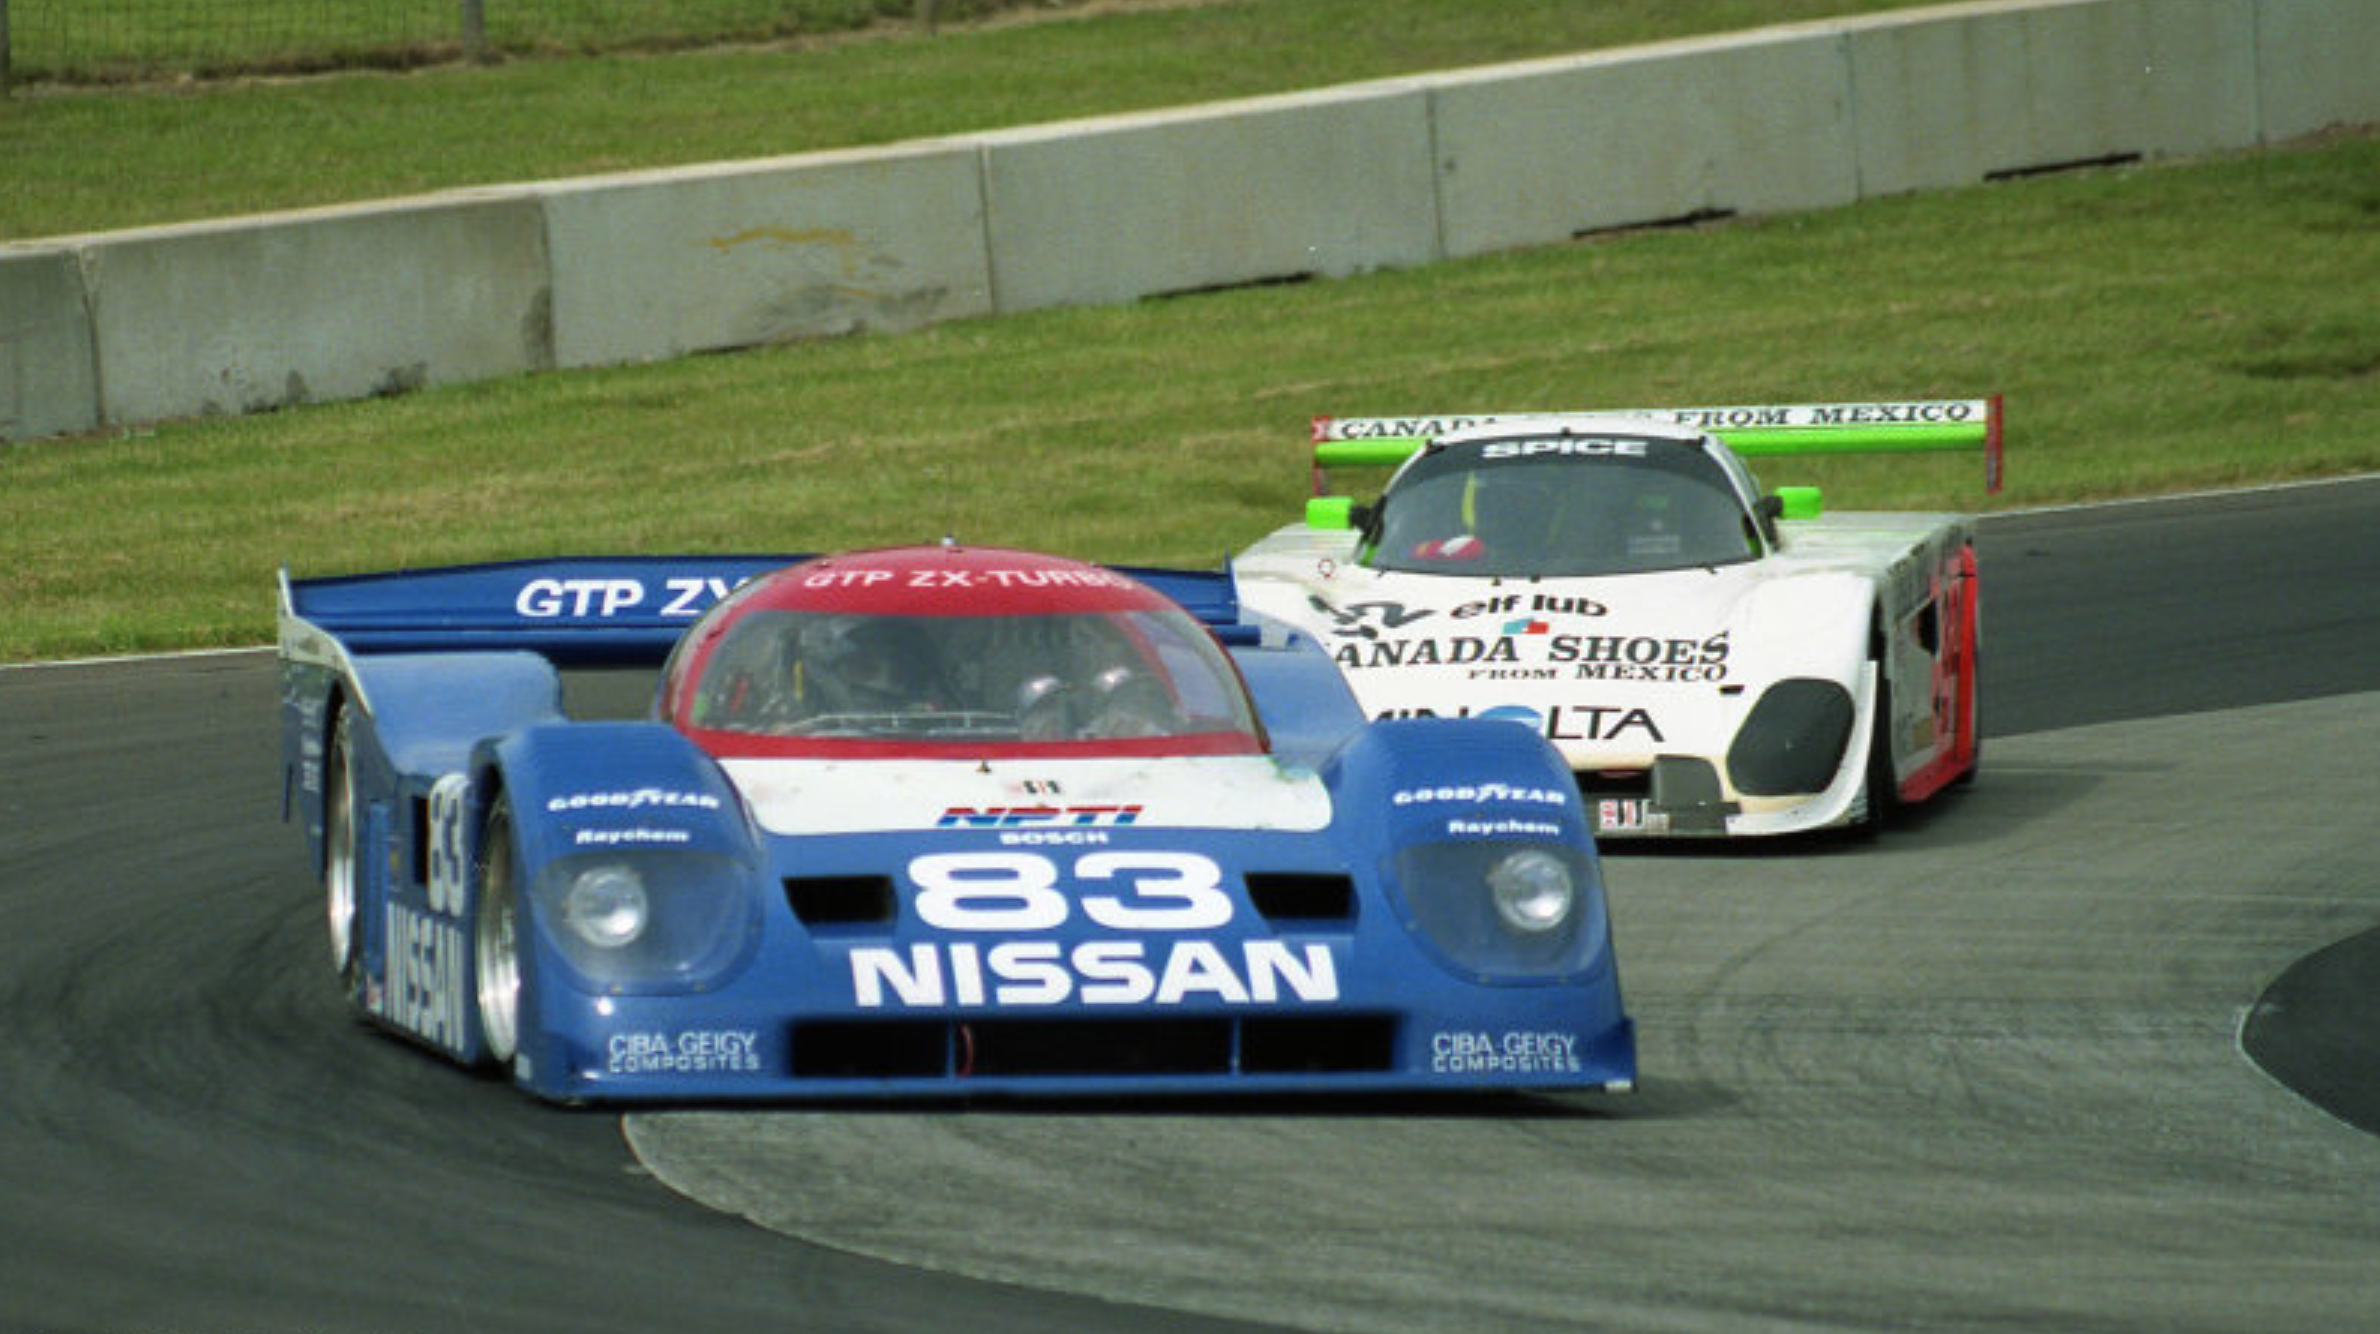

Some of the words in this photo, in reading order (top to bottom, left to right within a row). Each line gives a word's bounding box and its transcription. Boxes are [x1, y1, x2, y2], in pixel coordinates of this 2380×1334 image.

[1674, 409, 1791, 428] FROM
[1809, 404, 1972, 425] MEXICO
[1482, 438, 1648, 458] SPICE
[804, 569, 895, 588] GTP
[516, 578, 645, 617] GTP
[1450, 594, 1521, 620] elf
[1532, 594, 1609, 617] lub
[1327, 634, 1521, 669] ANADA
[1548, 629, 1731, 665] SHOES
[1468, 669, 1558, 679] FROM
[1575, 662, 1729, 682] MEXICO
[547, 787, 720, 812] GOODYEAR
[1393, 783, 1567, 806] GOODYEAR
[937, 804, 1144, 826] NPTI
[575, 828, 692, 845] Raychem
[1000, 831, 1110, 845] BOSCH
[1448, 819, 1560, 836] Raychem
[907, 851, 1235, 931] 83
[849, 941, 1340, 1008] NISSAN
[608, 1053, 761, 1074] COMPOSITES
[1432, 1055, 1582, 1073] COMPOSITES
